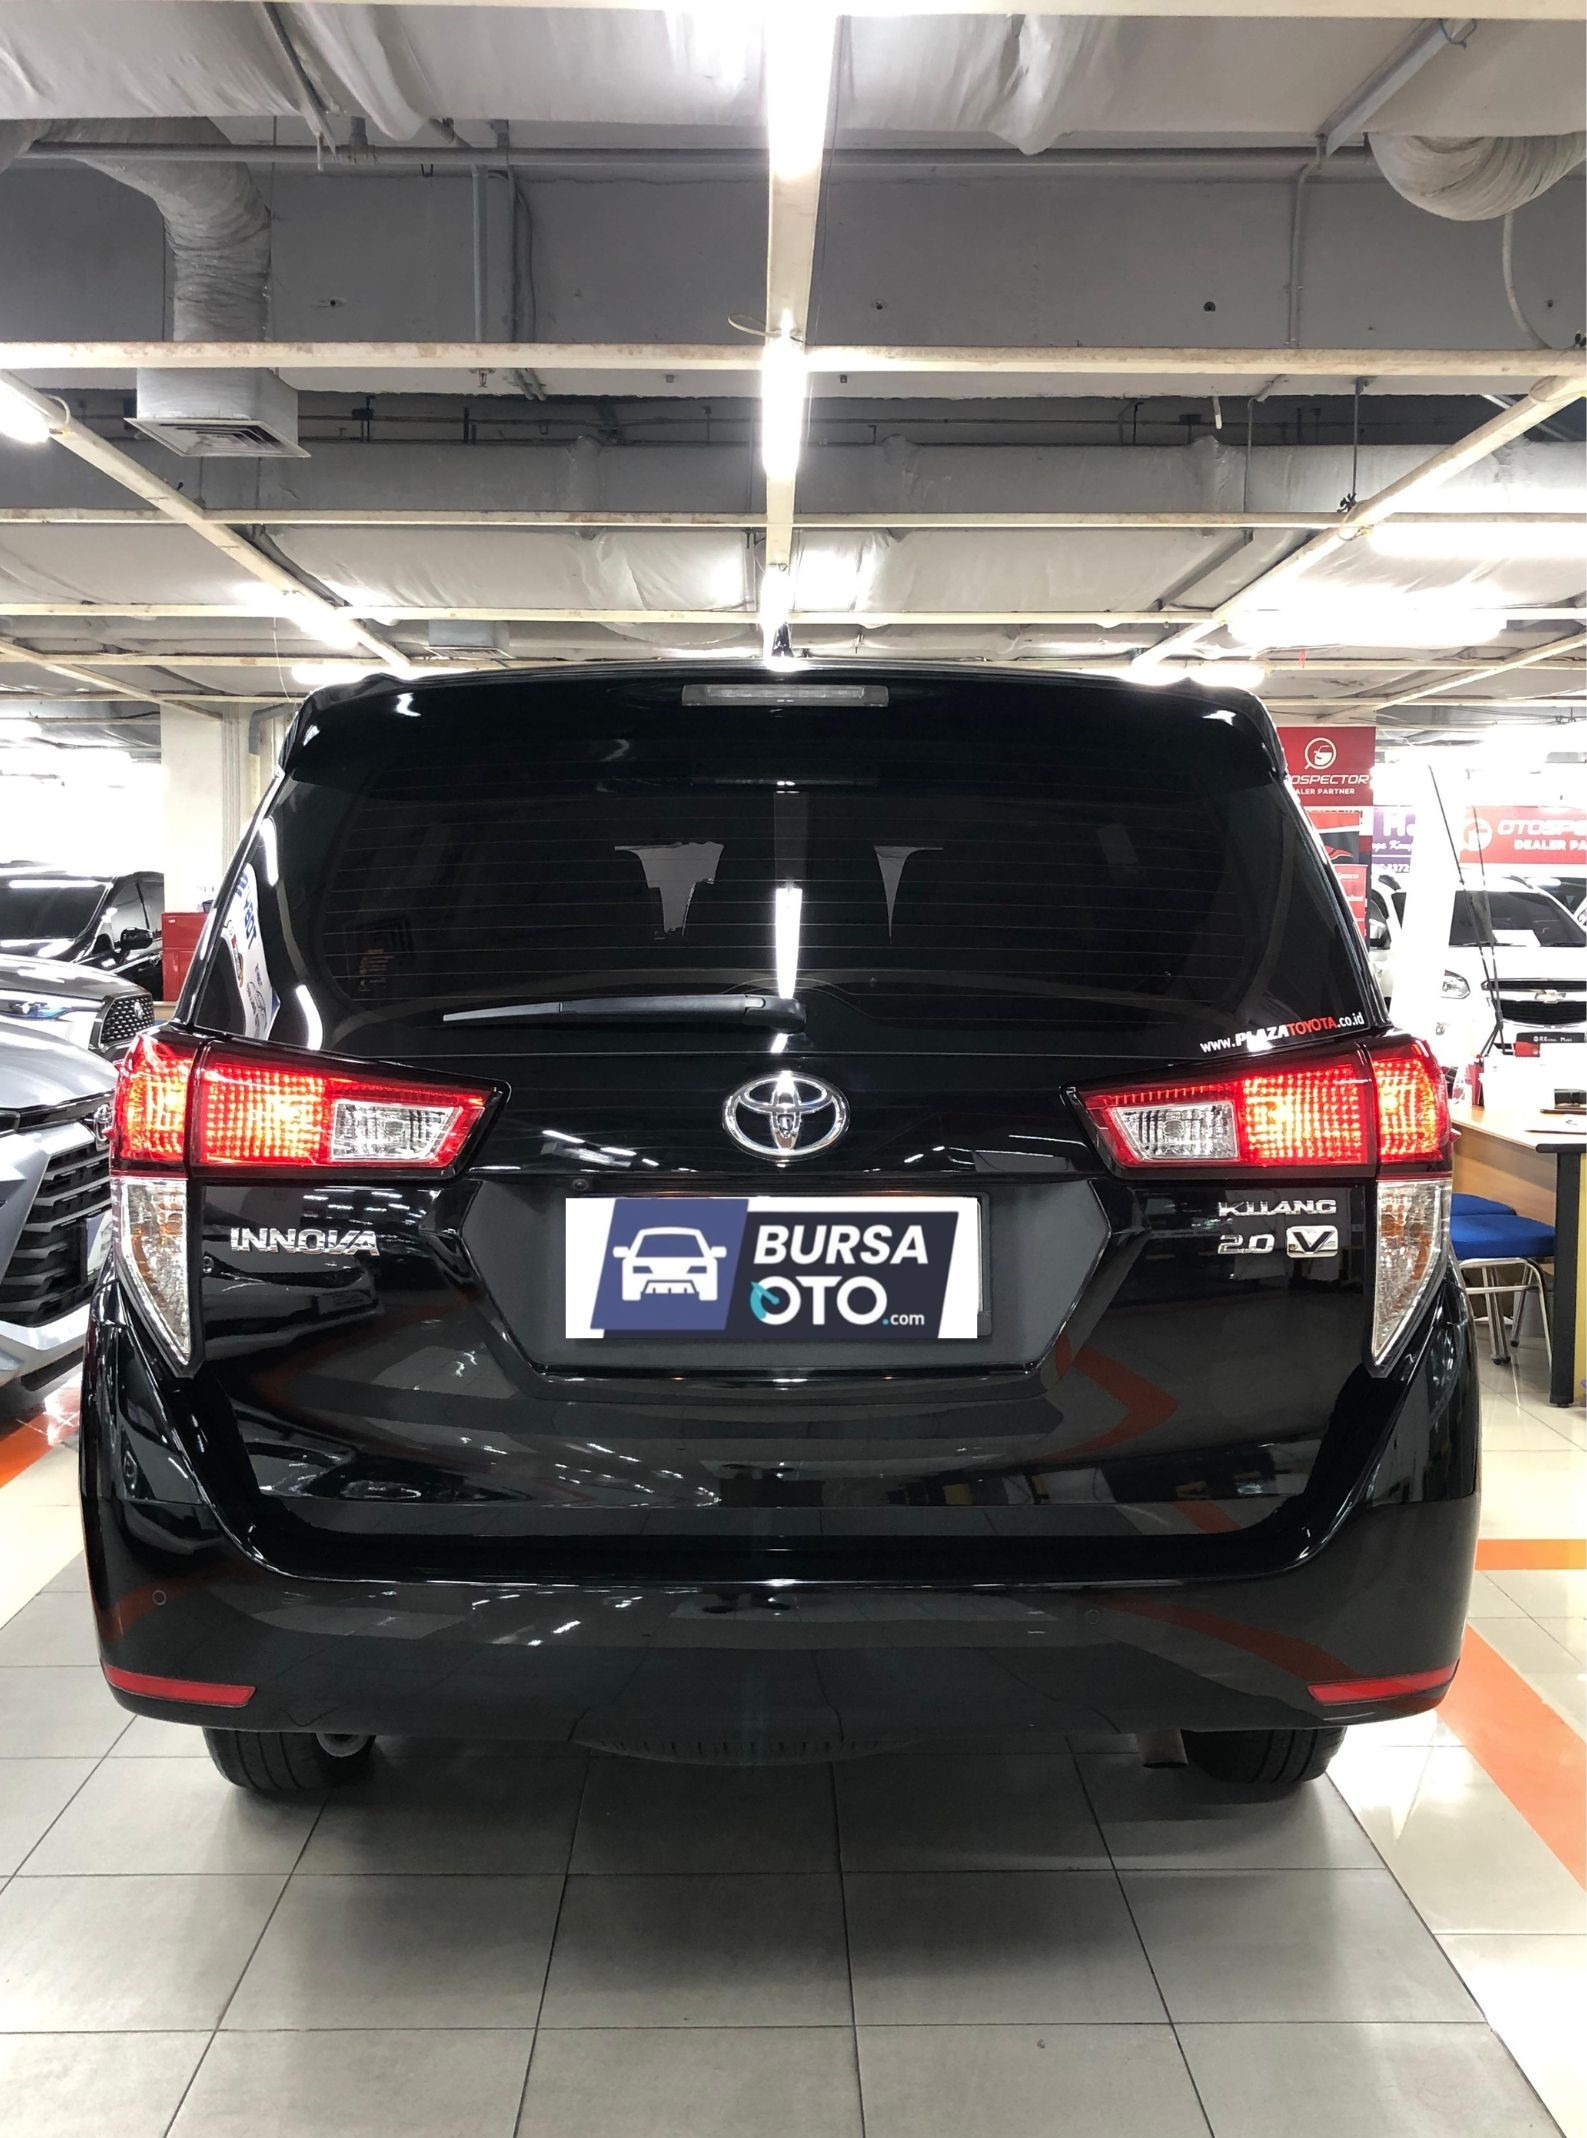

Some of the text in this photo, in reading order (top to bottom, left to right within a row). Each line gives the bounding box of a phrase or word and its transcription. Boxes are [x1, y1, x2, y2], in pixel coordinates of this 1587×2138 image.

[1291, 774, 1370, 785] OSPECTOR
[1513, 839, 1567, 851] DEALER
[230, 1227, 380, 1256] INNOVA
[1292, 1230, 1334, 1256] V
